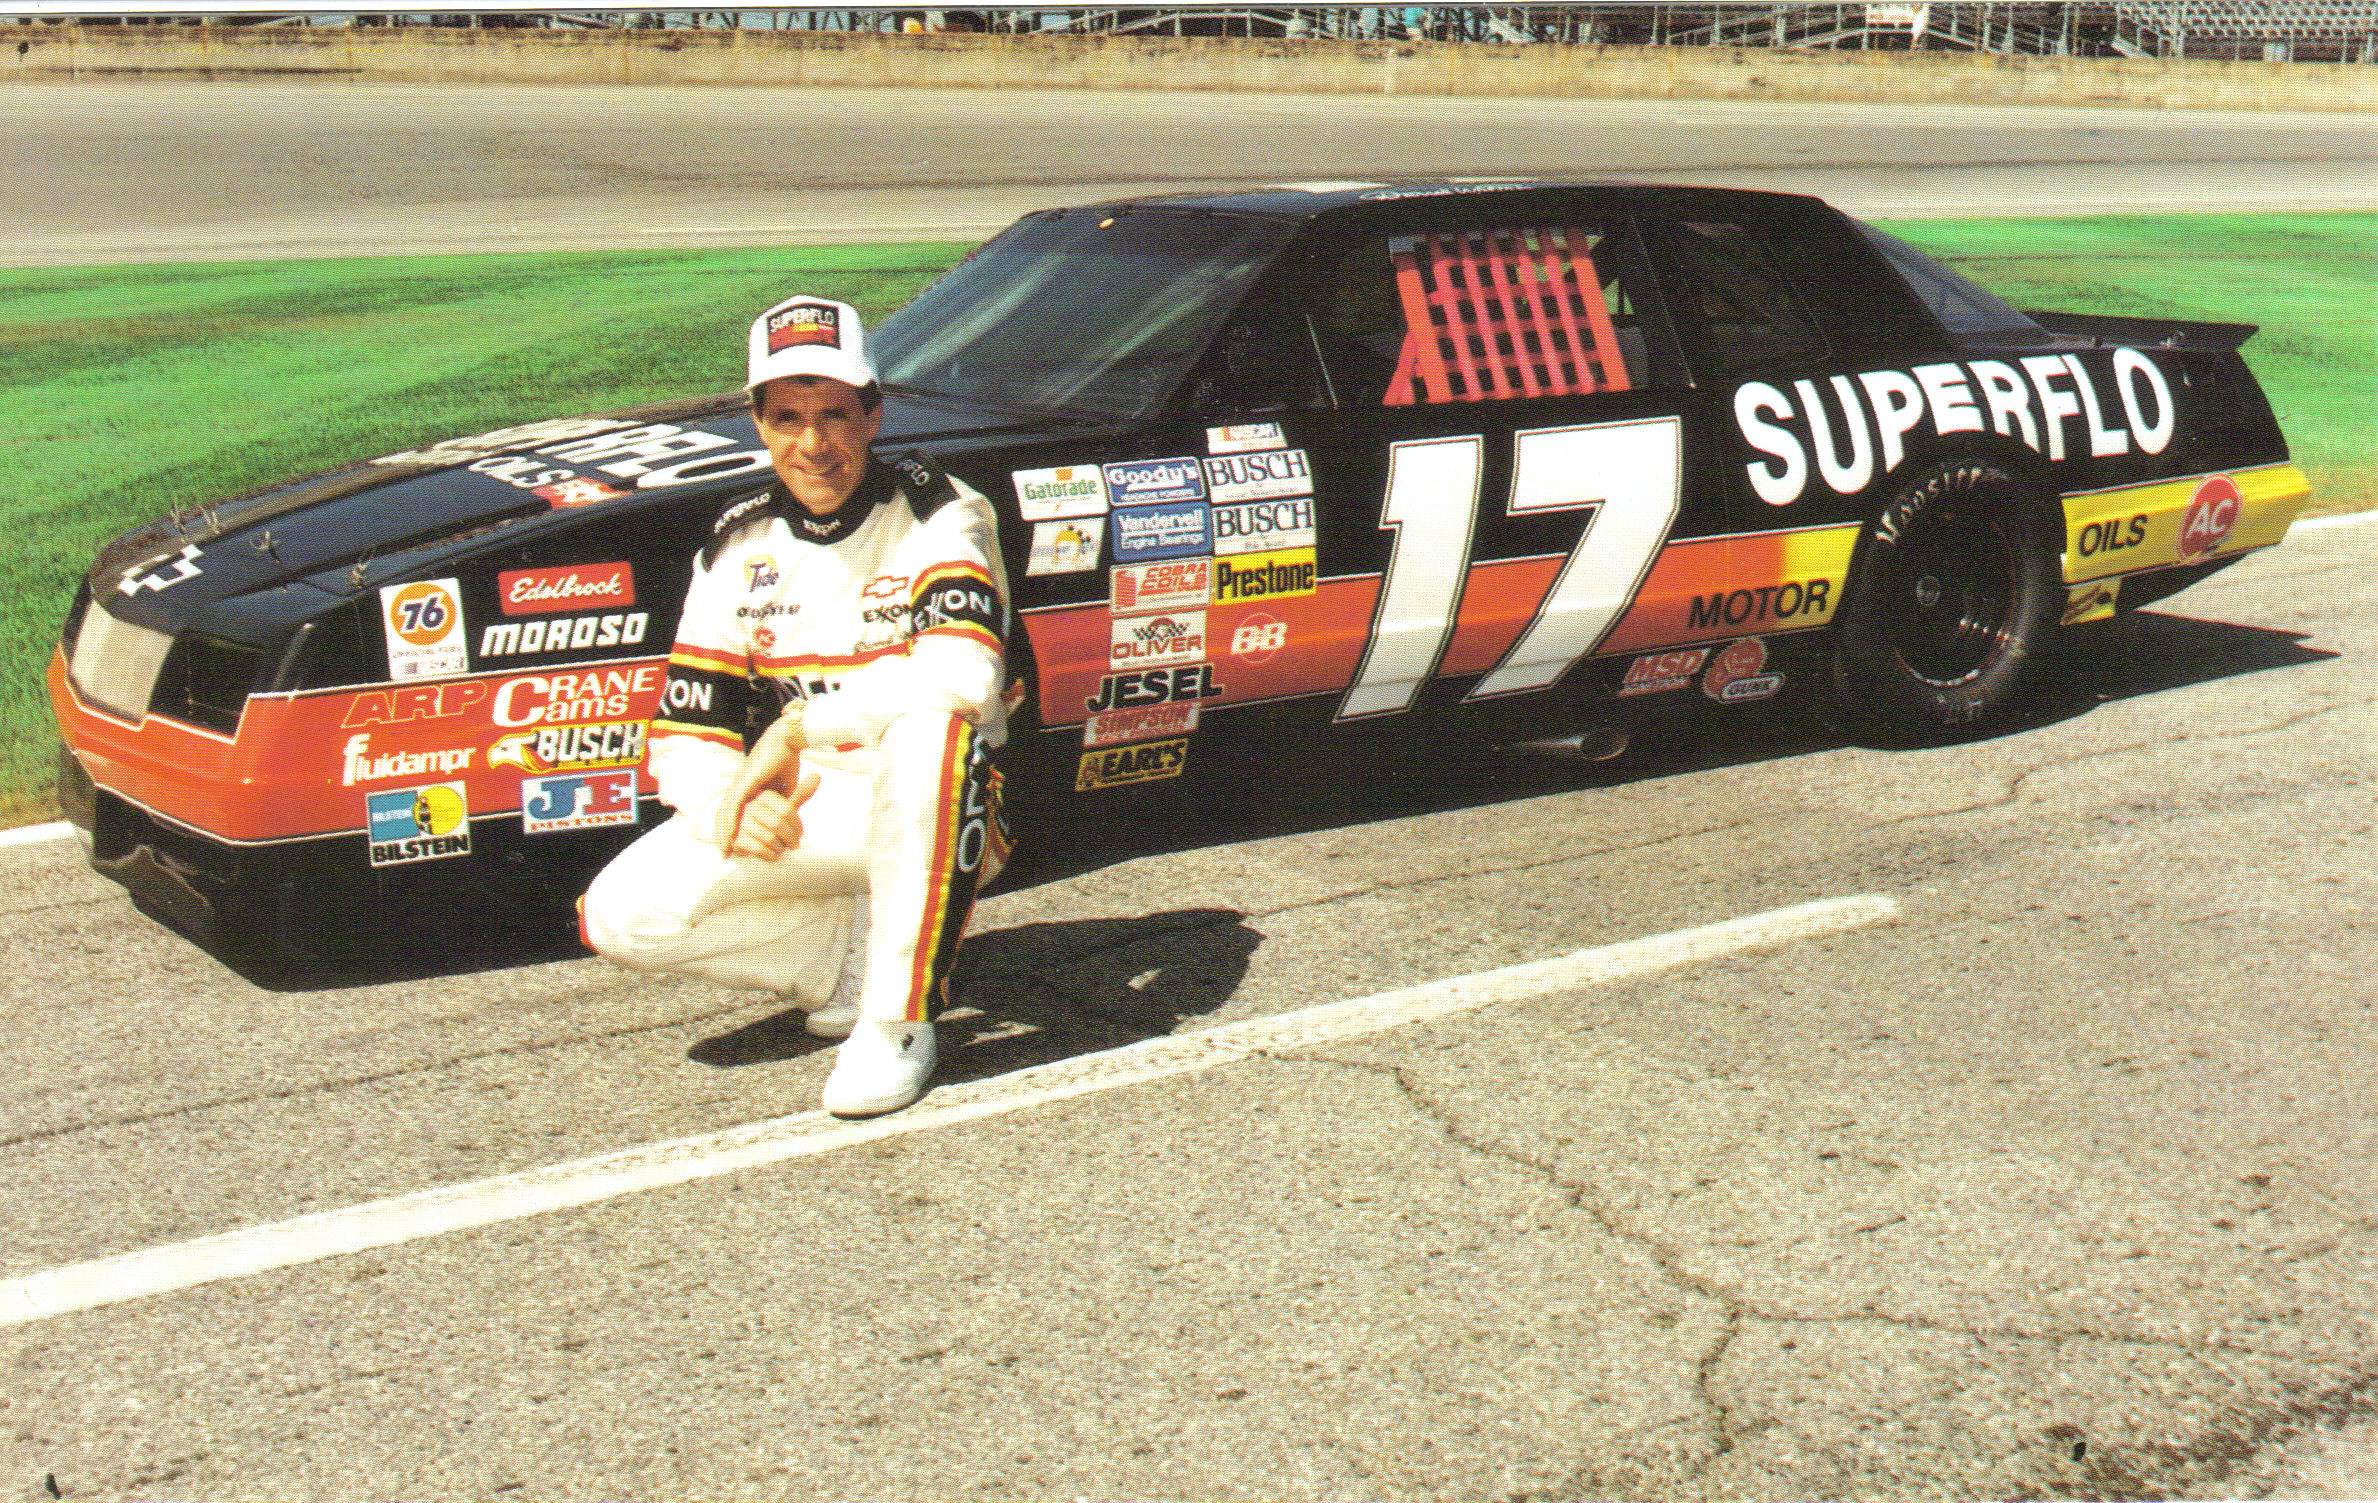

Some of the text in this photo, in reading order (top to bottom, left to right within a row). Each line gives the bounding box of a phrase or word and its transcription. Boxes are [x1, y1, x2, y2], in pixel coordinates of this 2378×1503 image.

[770, 307, 834, 333] SUPERFLO
[1733, 347, 2175, 506] SUPERFLO
[1108, 463, 1199, 490] Goody's
[1206, 451, 1309, 486] BUSCH
[1023, 477, 1098, 501] Gatorade
[1118, 508, 1204, 531] Vandervell
[1214, 499, 1314, 538] BUSCH
[2077, 514, 2147, 558] OILS
[2185, 498, 2234, 539] AC
[509, 573, 623, 603] Edelbrock
[1141, 573, 1208, 591] COILS
[1146, 562, 1208, 579] COBRA
[1216, 560, 1314, 600] Prestone
[1331, 415, 1682, 724] 17
[402, 595, 447, 632] 76
[1686, 578, 1831, 628] MOTOR
[479, 612, 650, 657] MOROSO
[1112, 635, 1202, 660] OLIVER
[1623, 650, 1704, 684] MSD
[340, 681, 487, 729] ARP
[493, 667, 659, 727] CRANE
[1086, 664, 1225, 713] JESEL
[1727, 678, 1771, 696] GUNK
[1094, 703, 1191, 735] SIMPSON
[342, 733, 477, 786] fluidampr
[537, 723, 644, 763] BUSCH
[528, 773, 631, 820] JE
[530, 813, 633, 831] PISTONS
[373, 834, 468, 863] BILSTEIN
